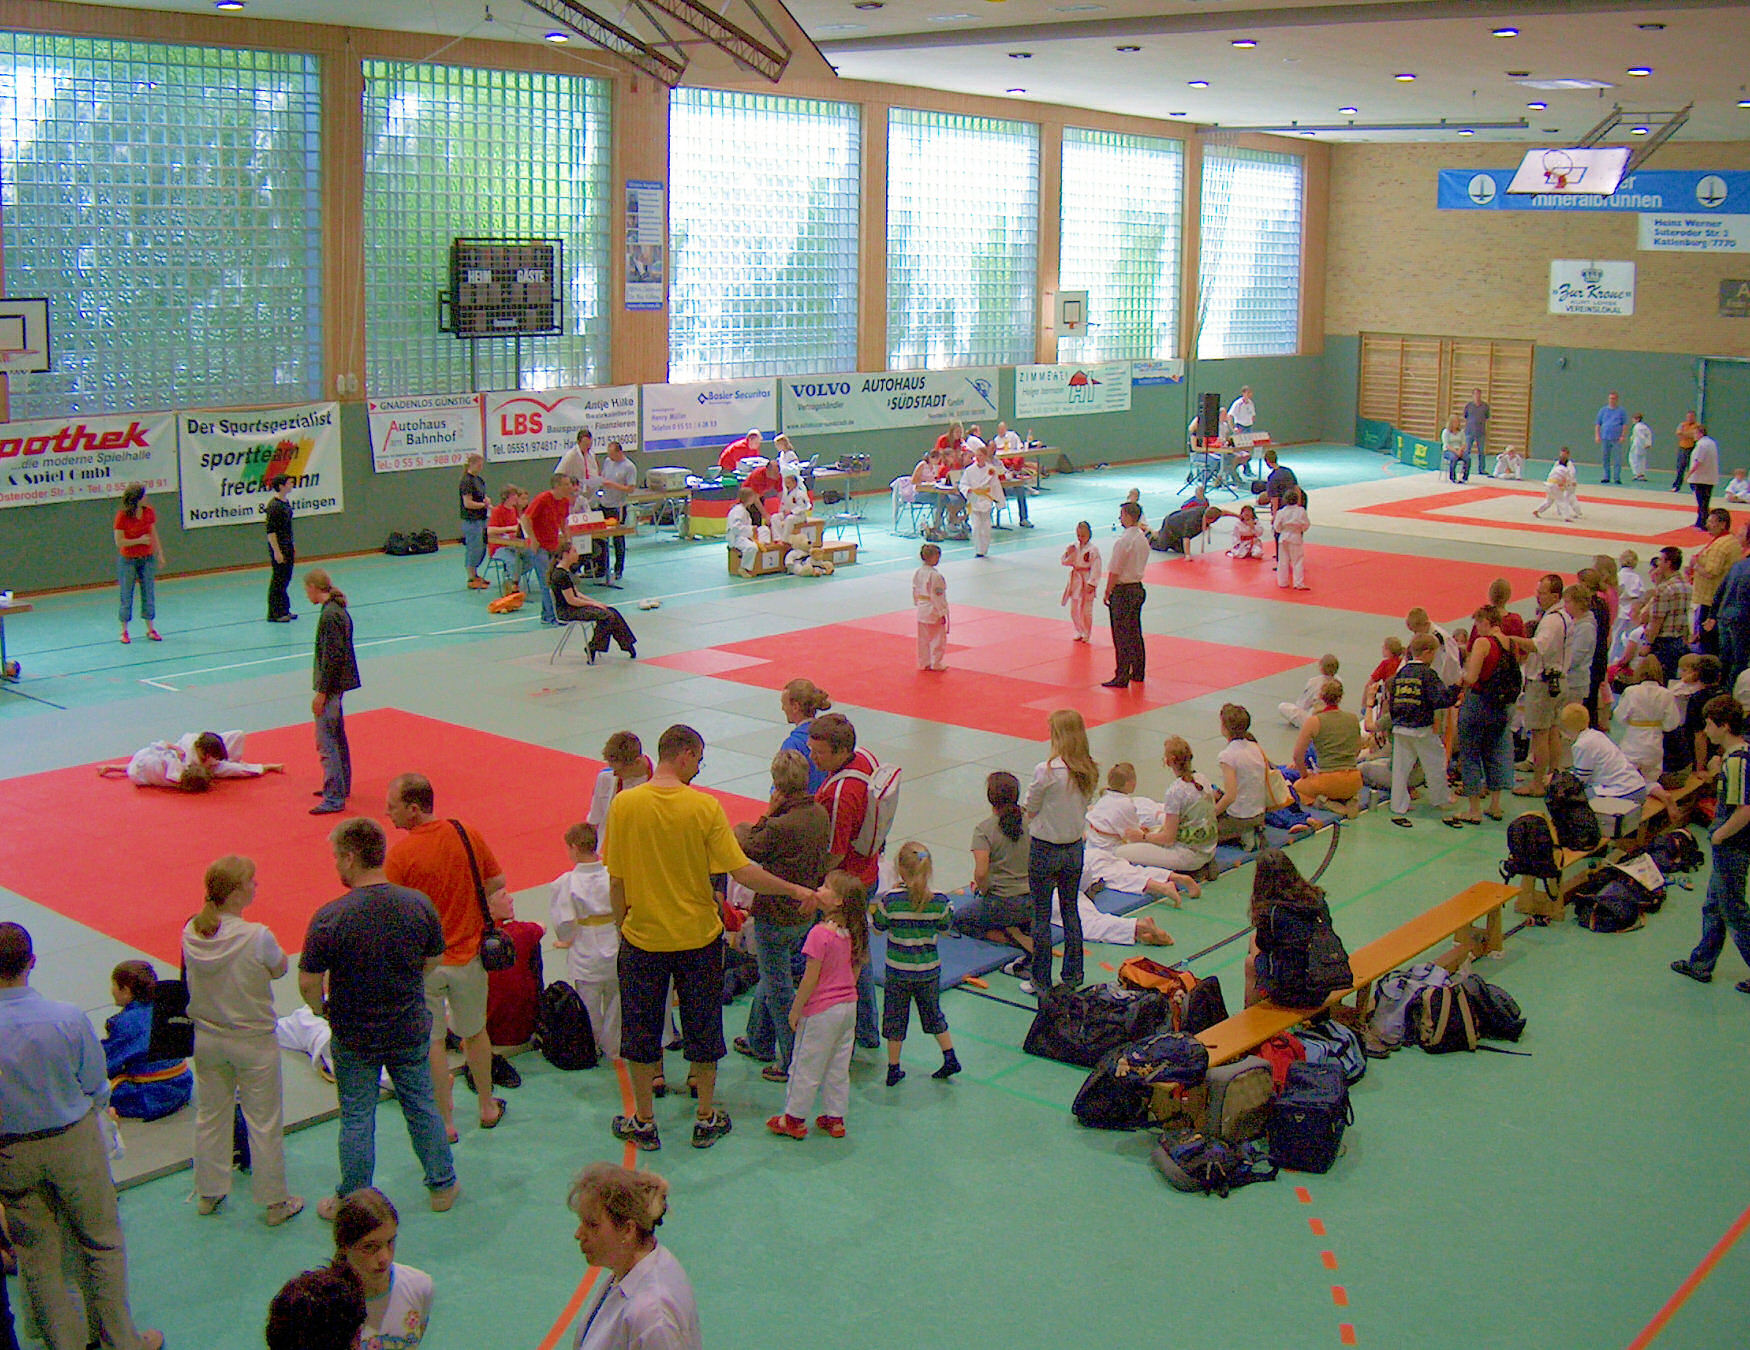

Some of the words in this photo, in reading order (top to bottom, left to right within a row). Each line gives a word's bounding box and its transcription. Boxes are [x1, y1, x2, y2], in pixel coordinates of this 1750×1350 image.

[791, 382, 851, 398] VOLVO
[861, 376, 926, 394] AUTOHAUS
[380, 398, 432, 410] GNADENLOS
[435, 395, 471, 407] GÜNSTIG
[585, 400, 609, 411] Antje
[188, 419, 215, 434] Der
[219, 411, 332, 437] Sportspezialist
[501, 412, 543, 437] LBS
[407, 430, 457, 445] Bahnhof
[43, 453, 93, 467] moderne
[97, 450, 151, 466] Spielhalle
[200, 445, 299, 470] sportteam
[190, 505, 254, 520] Northeim
[258, 503, 267, 514] &
